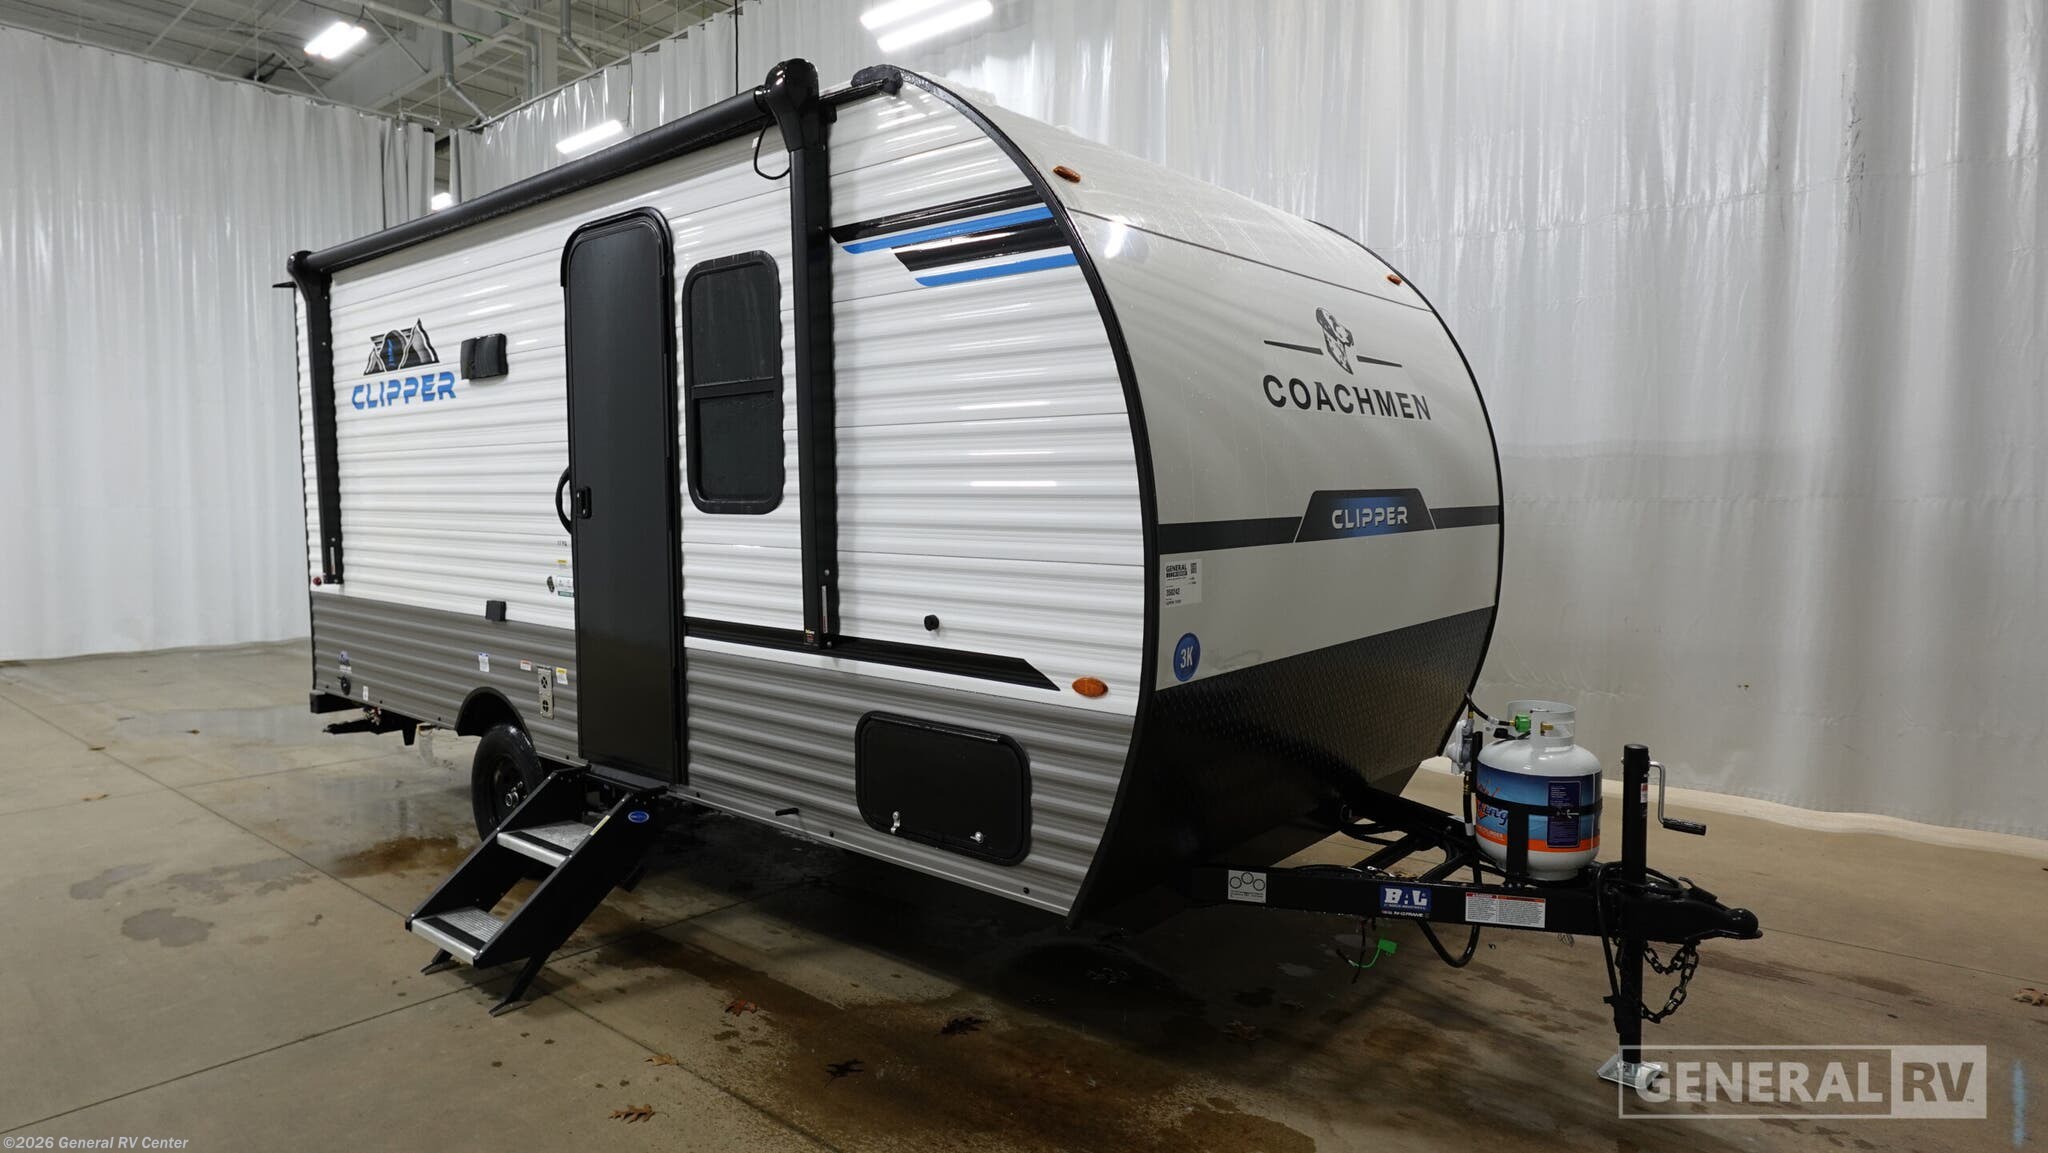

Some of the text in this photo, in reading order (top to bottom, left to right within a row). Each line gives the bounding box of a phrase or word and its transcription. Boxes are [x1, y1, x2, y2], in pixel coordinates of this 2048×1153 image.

[352, 371, 456, 410] CLIPPER
[1263, 374, 1431, 420] COACHMEN
[1331, 506, 1408, 529] CLIPPER
[1165, 564, 1187, 573] GENERAL
[1179, 645, 1194, 669] 3K
